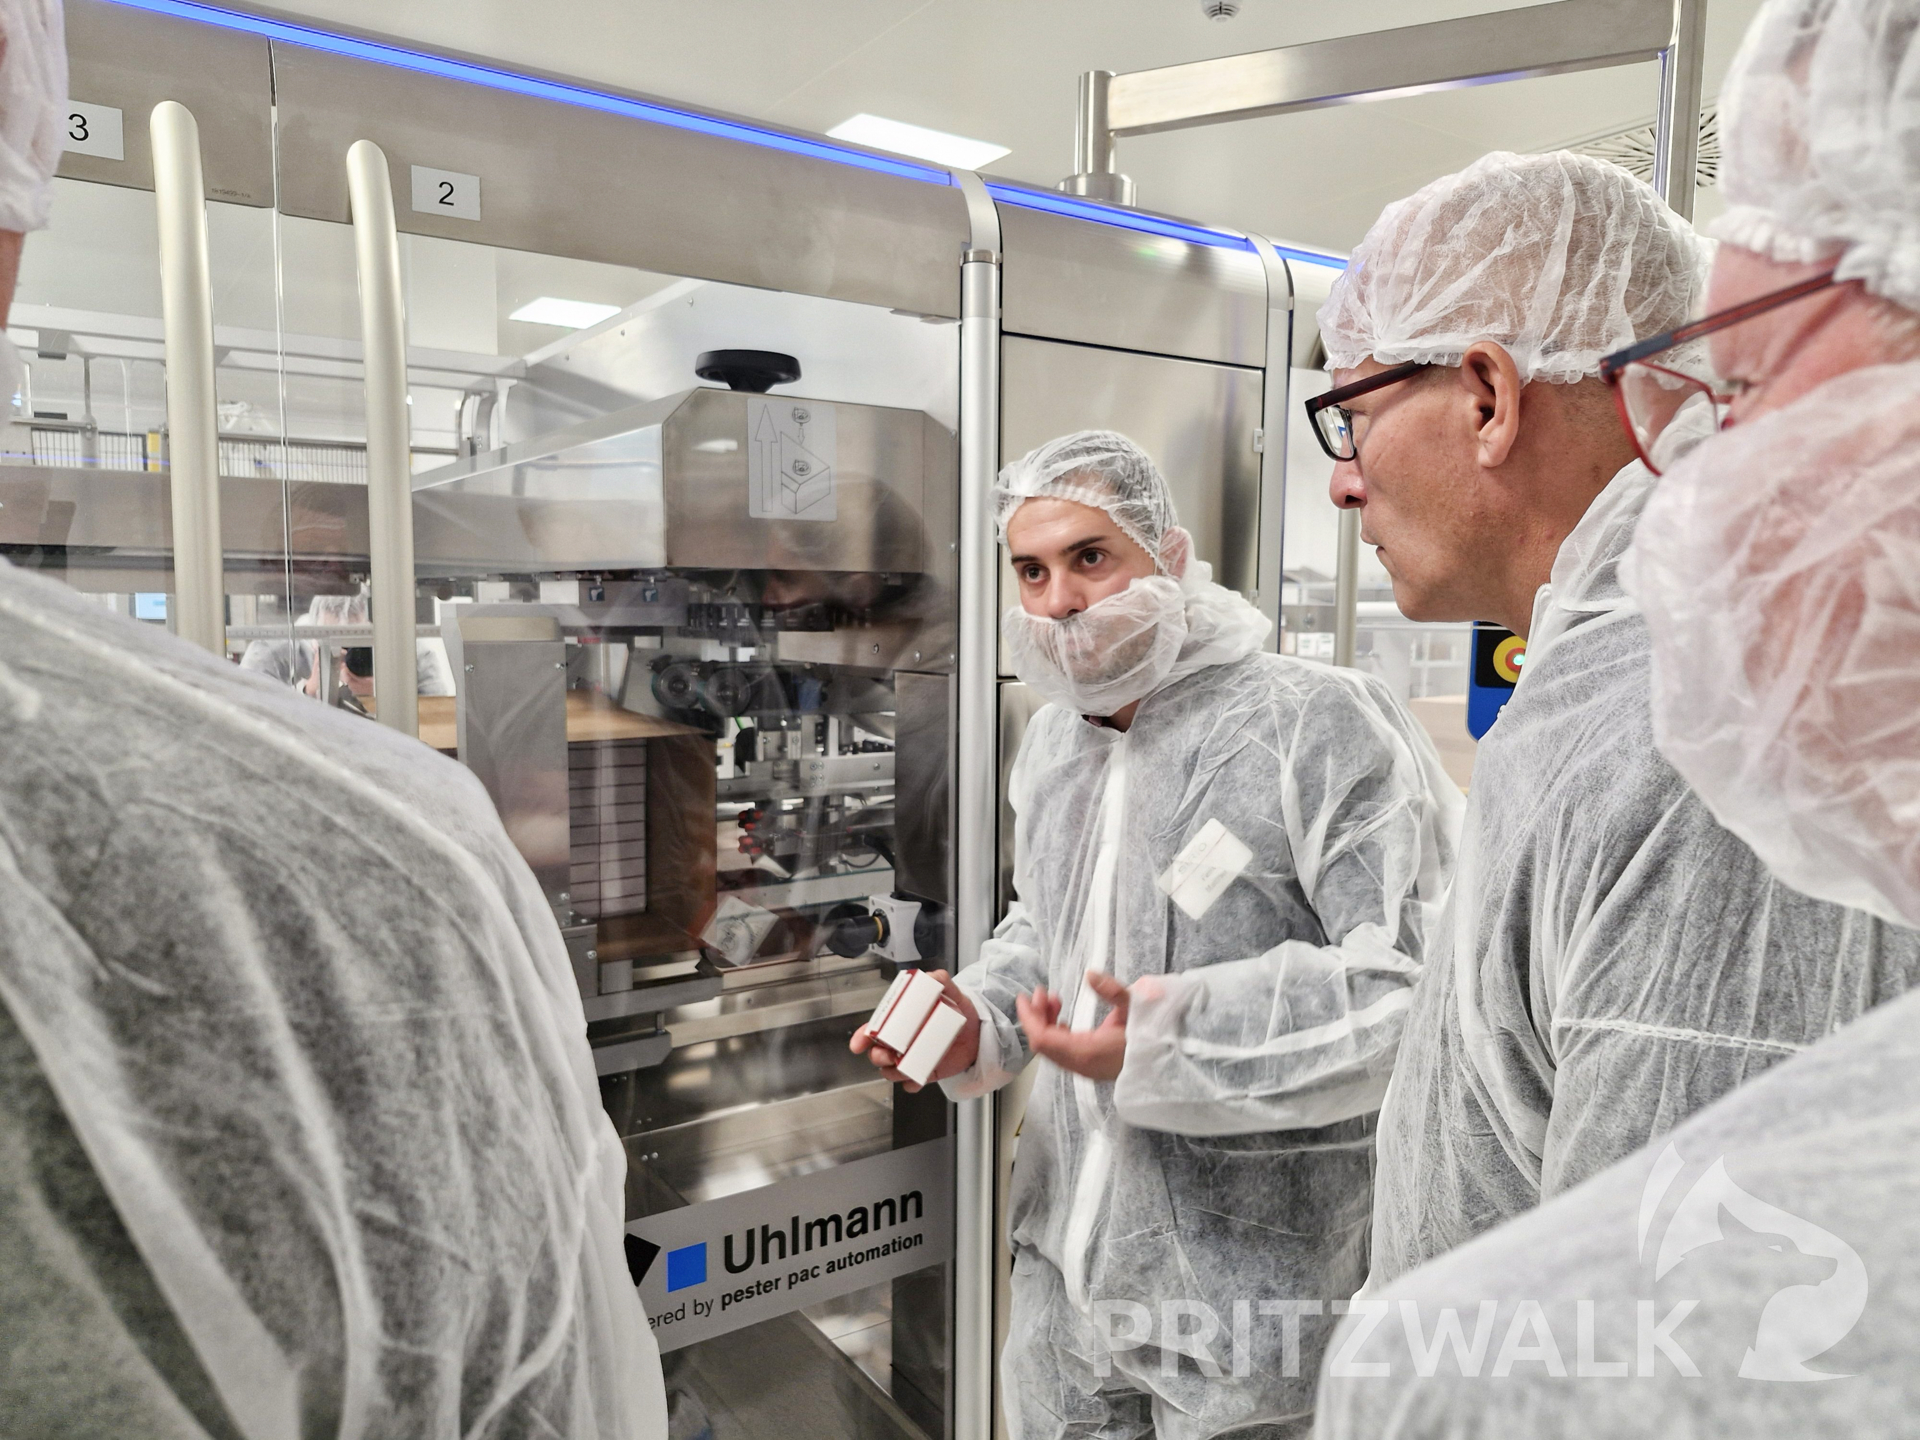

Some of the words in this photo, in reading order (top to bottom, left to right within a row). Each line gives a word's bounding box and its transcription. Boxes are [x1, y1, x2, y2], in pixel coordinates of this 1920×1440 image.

[68, 113, 89, 142] 3
[438, 181, 454, 206] 2
[723, 1190, 923, 1274] Uhlmann
[693, 1298, 714, 1317] by
[721, 1276, 781, 1311] pester
[787, 1264, 820, 1290] pac
[826, 1232, 923, 1274] automation
